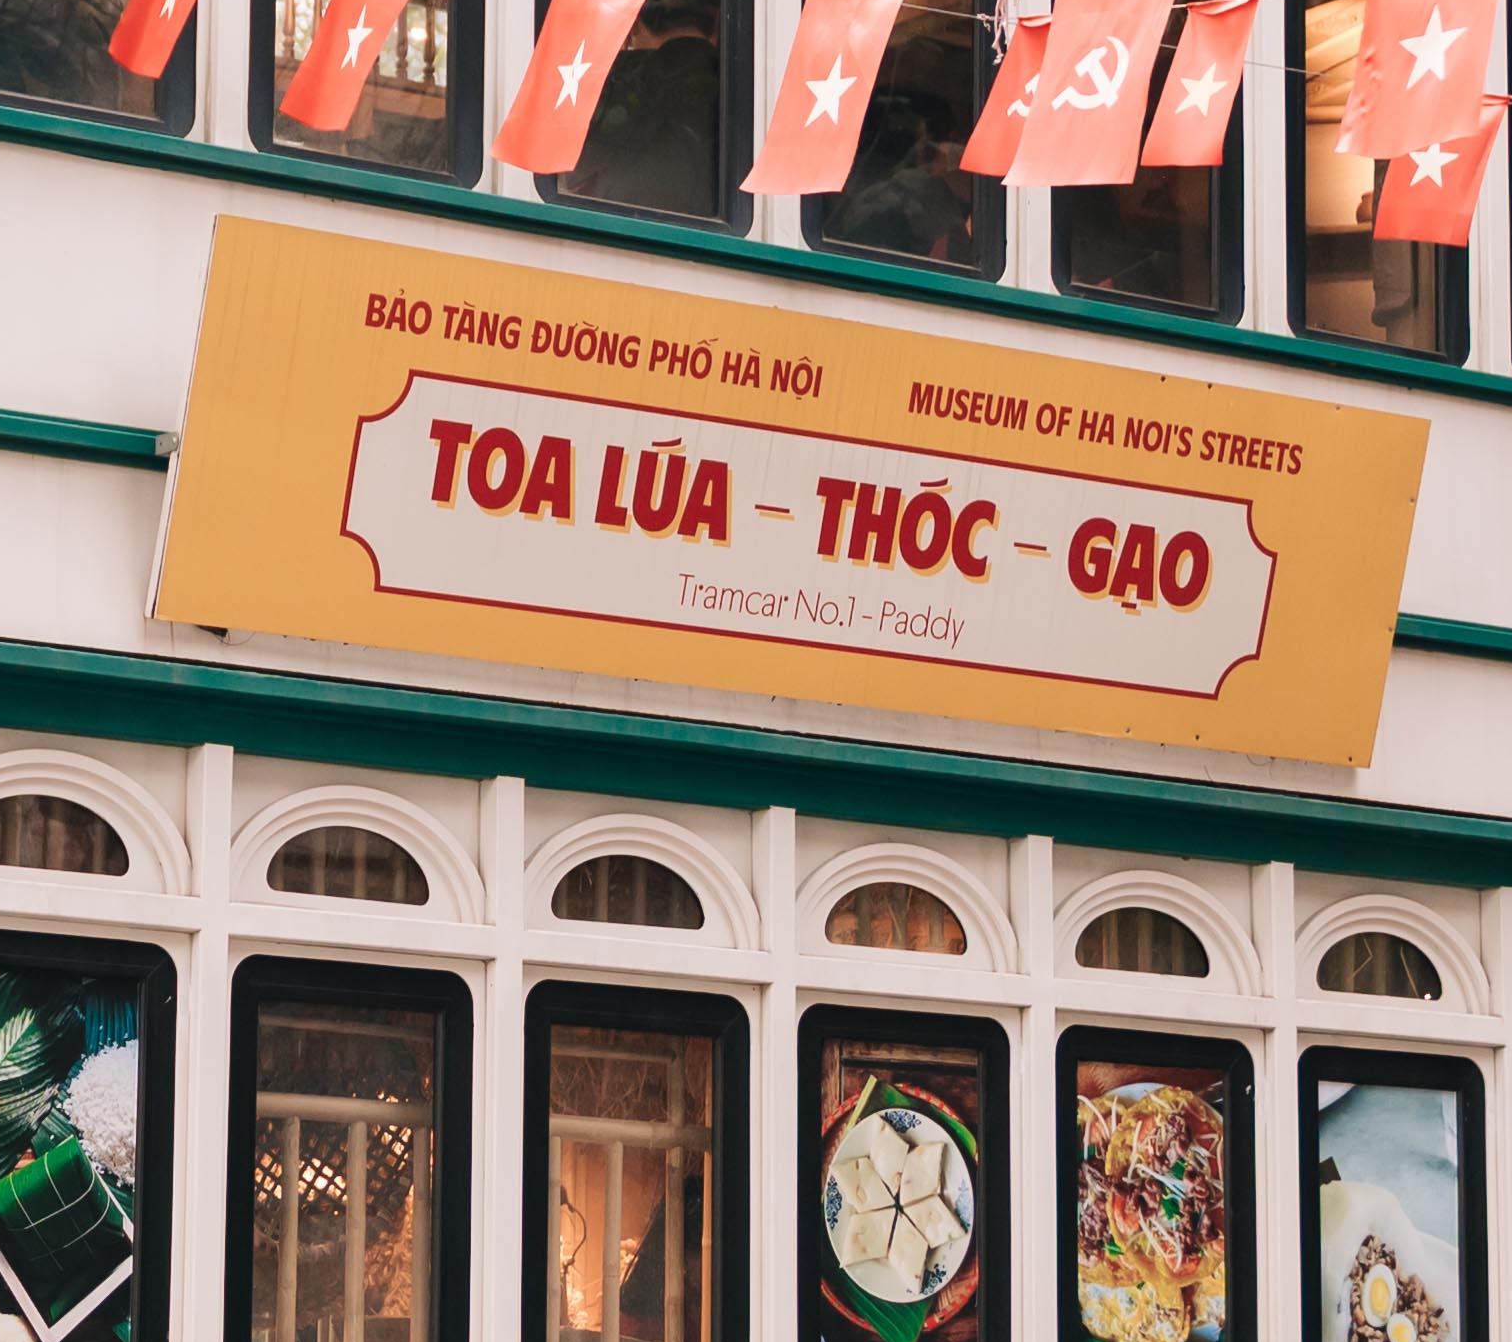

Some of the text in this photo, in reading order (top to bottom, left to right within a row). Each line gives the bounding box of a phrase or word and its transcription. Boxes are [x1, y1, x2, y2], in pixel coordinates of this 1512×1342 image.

[364, 288, 825, 401] BẢO TÀNG ĐƯỜNG PHỐ HÀ NỘI
[907, 381, 1305, 476] MUSEUM OF HA NOI'S STREETS
[429, 418, 574, 523] TOA
[594, 437, 731, 545] LÚA
[816, 476, 999, 582] THÓC
[1067, 516, 1212, 615] GẠO
[678, 573, 790, 619] Tramcar
[794, 588, 857, 629] No.1
[879, 599, 966, 651] Paddy
